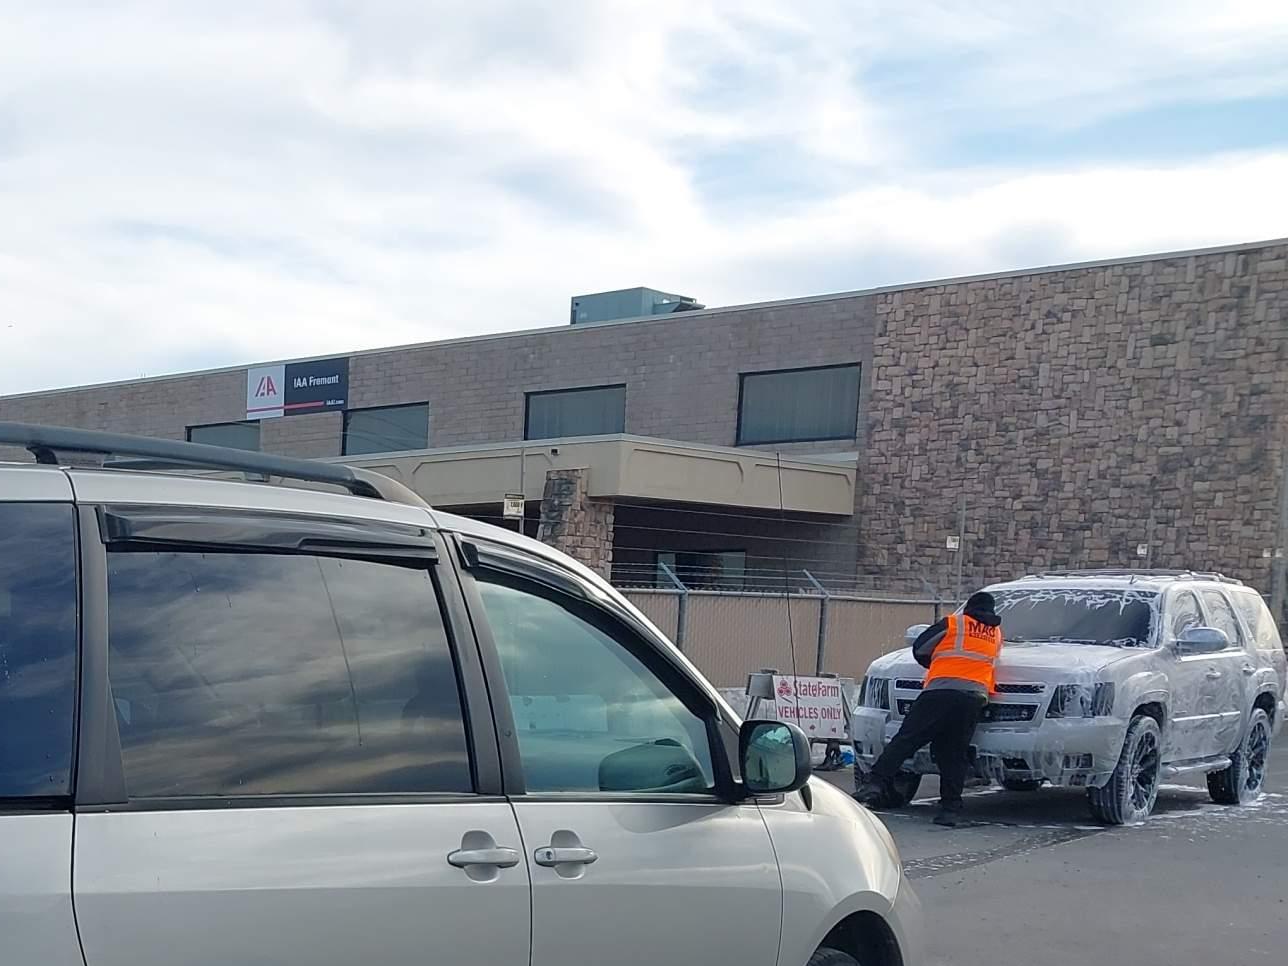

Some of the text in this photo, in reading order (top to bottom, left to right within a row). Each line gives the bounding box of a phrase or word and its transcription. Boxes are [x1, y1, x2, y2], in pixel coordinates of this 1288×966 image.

[294, 374, 339, 388] IAA Fremont
[778, 706, 841, 719] VEHICLES ONLY
